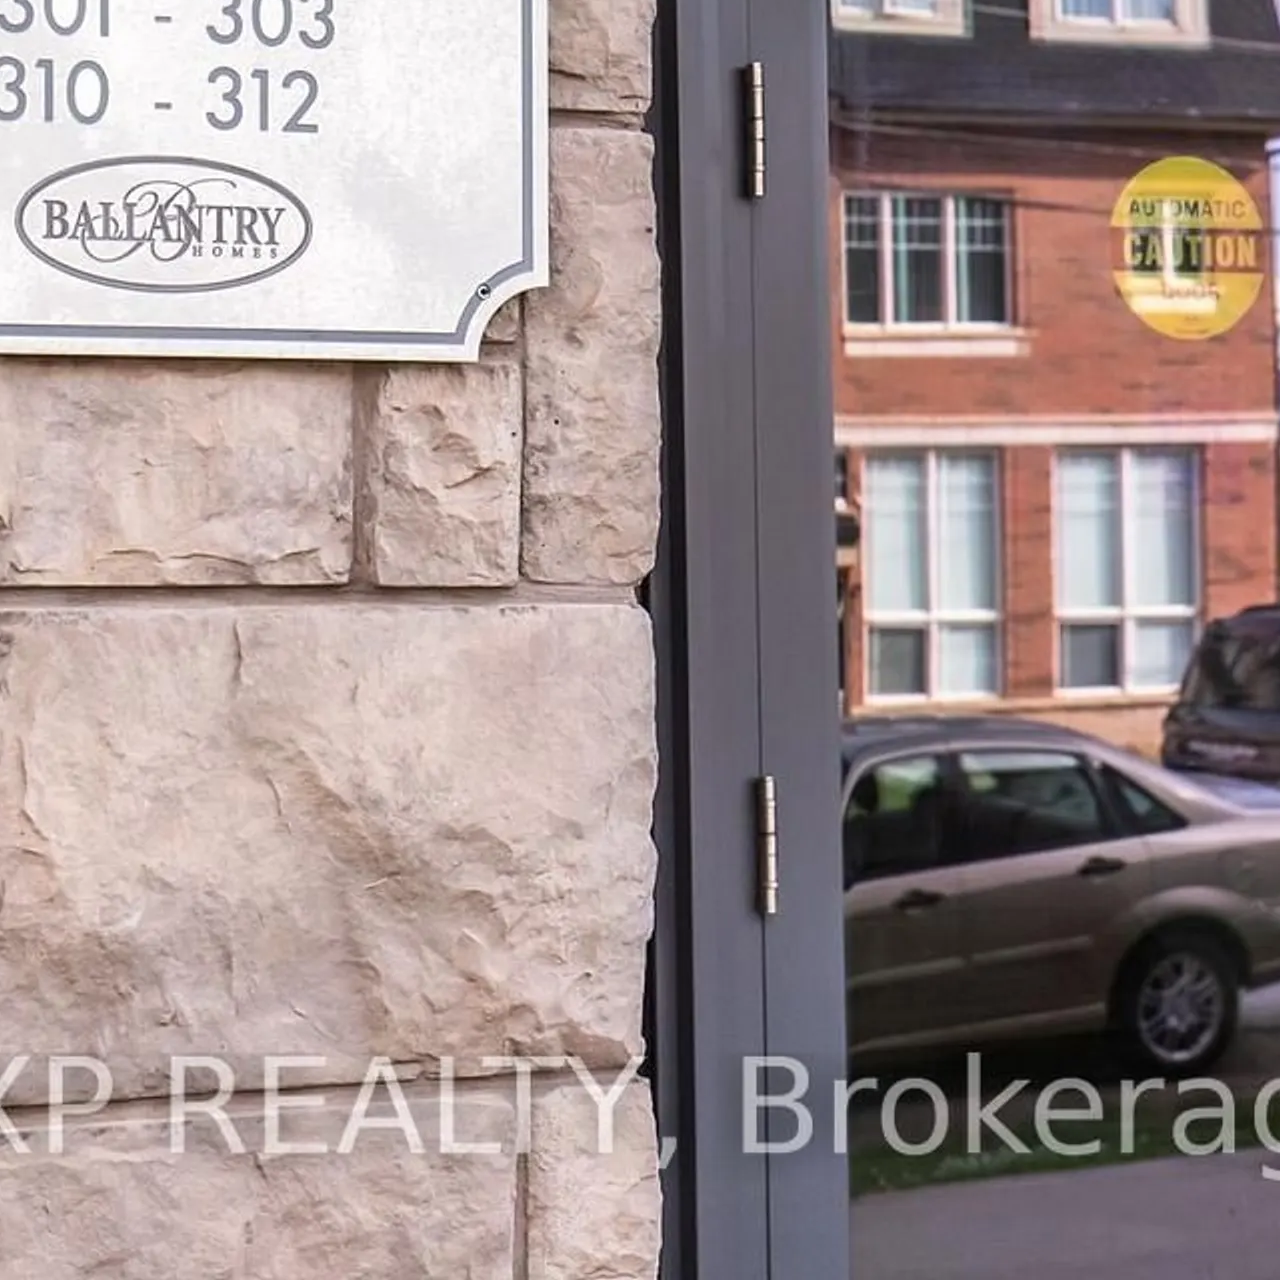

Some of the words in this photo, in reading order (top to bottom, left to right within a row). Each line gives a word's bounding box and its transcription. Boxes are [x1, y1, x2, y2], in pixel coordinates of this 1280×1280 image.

[205, 66, 319, 134] 312
[42, 199, 287, 245] BALLANTRY
[191, 244, 279, 259] HOMES
